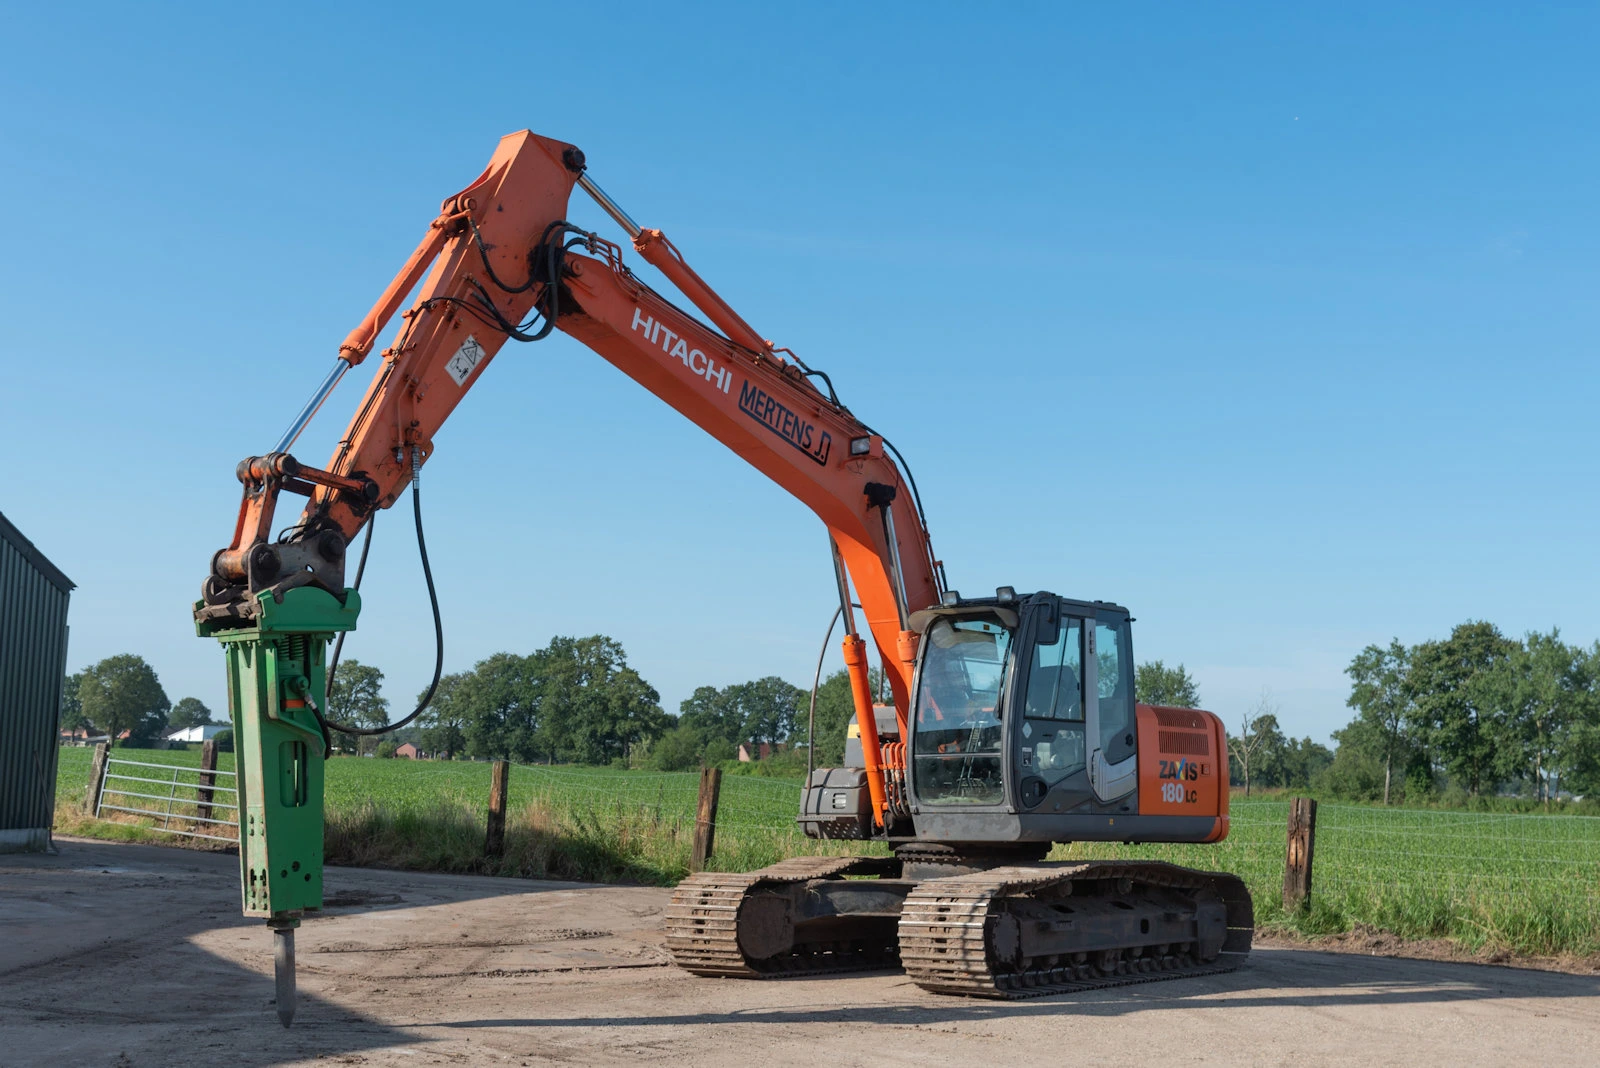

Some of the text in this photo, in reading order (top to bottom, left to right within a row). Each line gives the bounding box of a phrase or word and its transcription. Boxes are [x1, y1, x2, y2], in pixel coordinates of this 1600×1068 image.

[631, 307, 732, 394] HITACHI
[739, 379, 814, 449] MERTENS
[1159, 757, 1198, 781] ZAXIS
[1161, 783, 1197, 803] 180 LC
